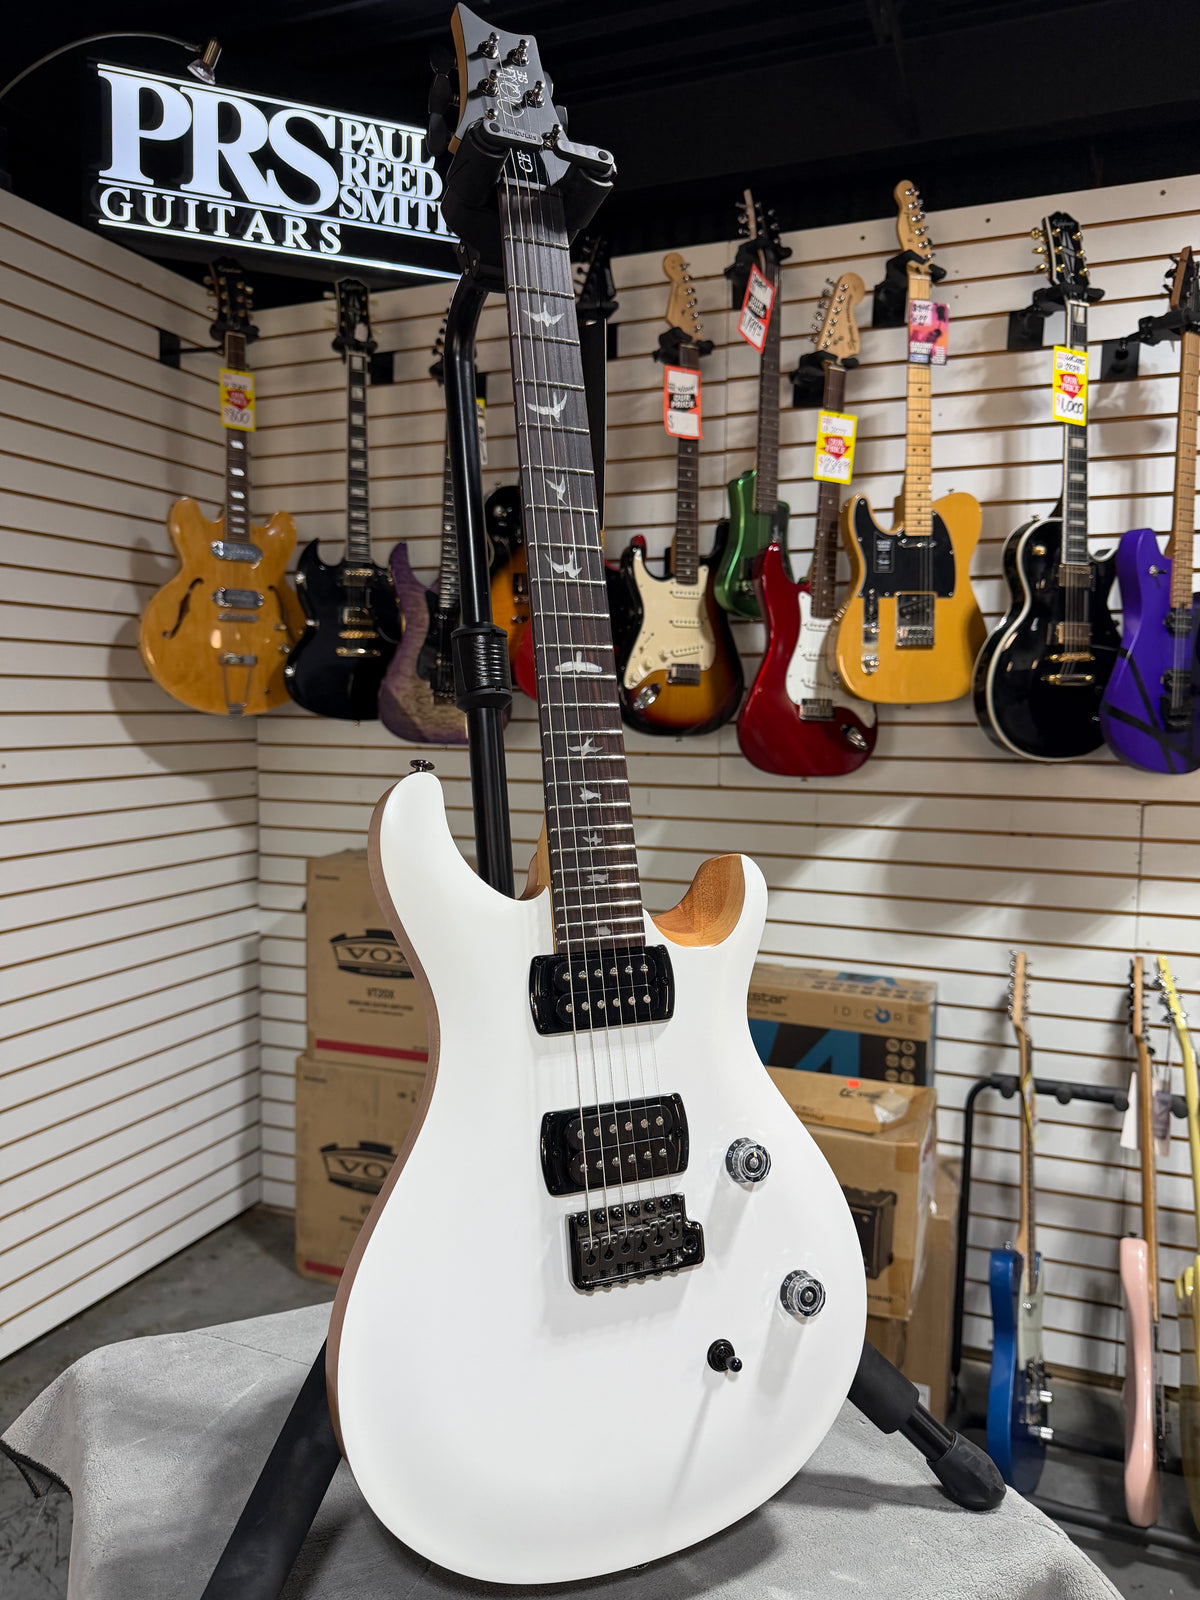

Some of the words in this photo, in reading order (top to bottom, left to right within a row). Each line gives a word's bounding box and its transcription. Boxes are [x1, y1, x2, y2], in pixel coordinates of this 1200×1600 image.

[517, 71, 528, 84] SE
[502, 127, 537, 141] HERCULES
[98, 70, 339, 213] PRS
[339, 118, 436, 169] PAUL
[339, 152, 443, 201] REED
[99, 187, 341, 254] GUITARS
[1062, 374, 1078, 385] OUR
[1060, 383, 1081, 393] PRICE
[671, 400, 696, 409] PRICE
